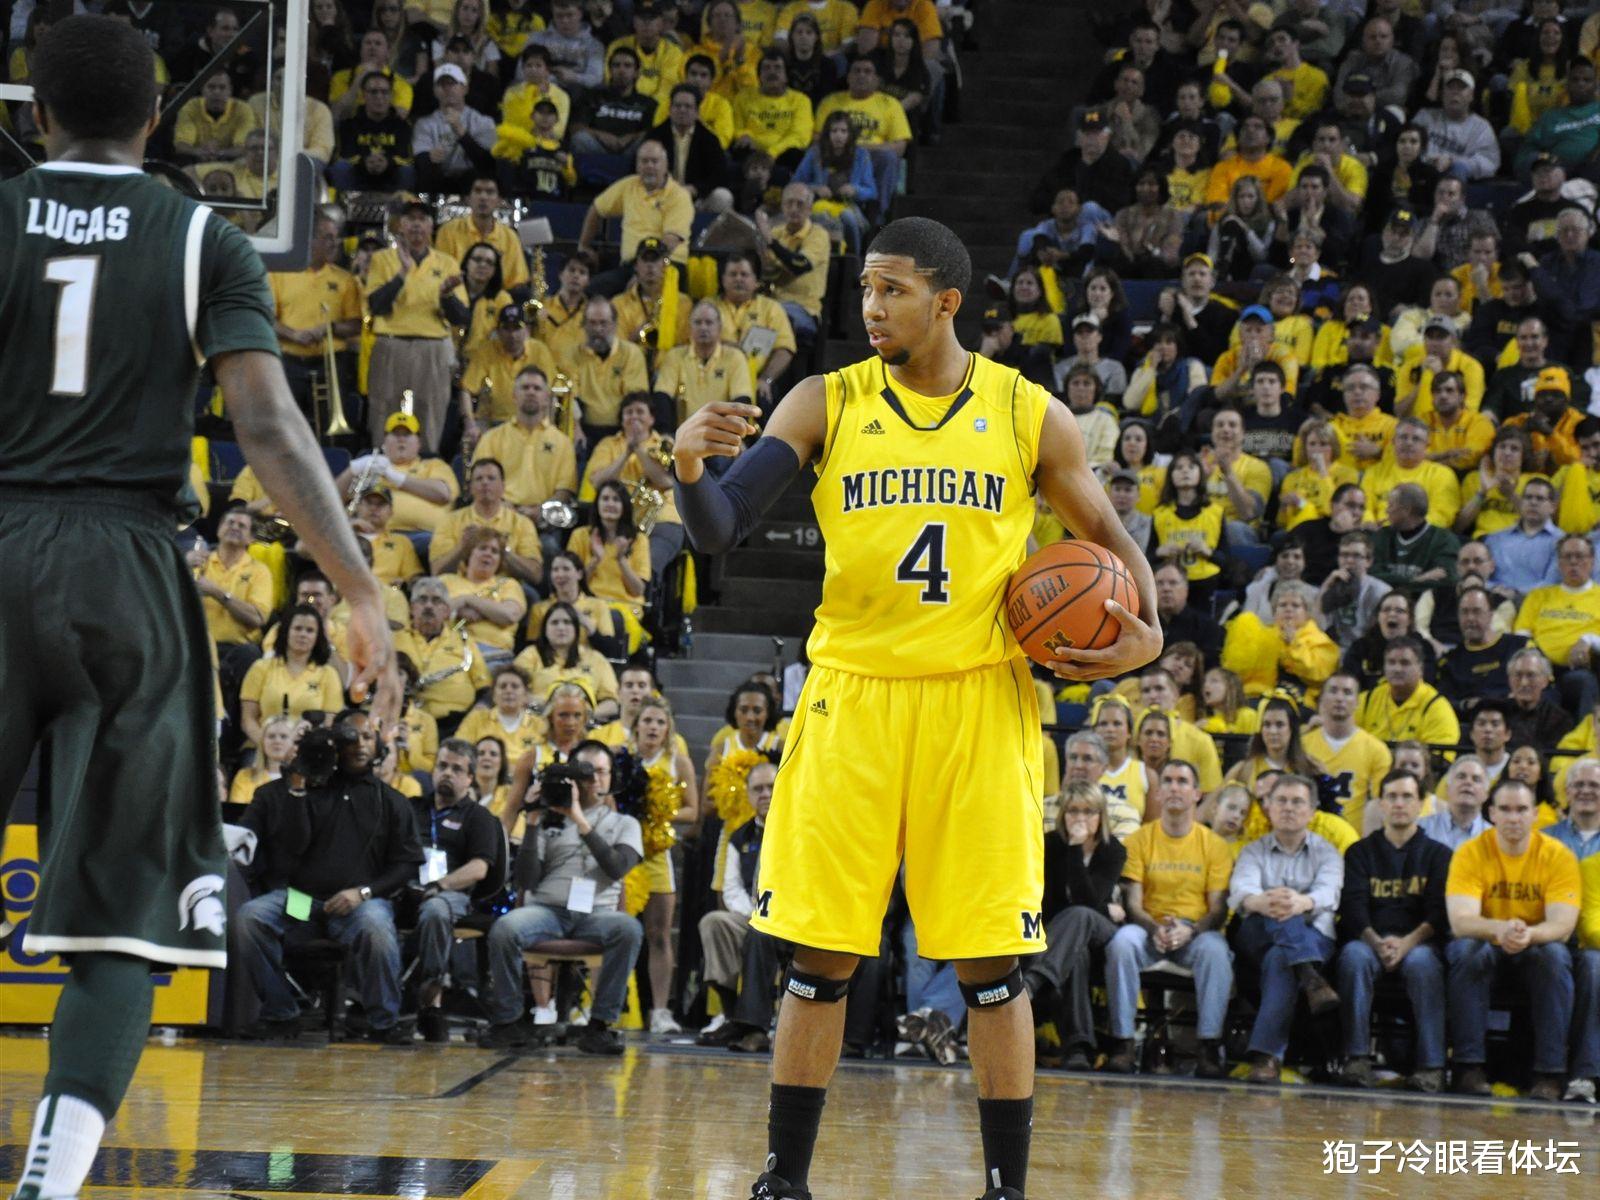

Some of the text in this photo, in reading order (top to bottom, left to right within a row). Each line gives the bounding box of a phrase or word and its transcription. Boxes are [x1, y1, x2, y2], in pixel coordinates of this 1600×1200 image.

[25, 197, 131, 245] LUCAS
[43, 254, 102, 398] 1
[841, 467, 1006, 515] MICHIGAN
[794, 527, 819, 546] 19
[895, 521, 951, 605] 4
[1030, 574, 1070, 610] THE
[1101, 784, 1127, 800] M
[1021, 911, 1042, 939] M
